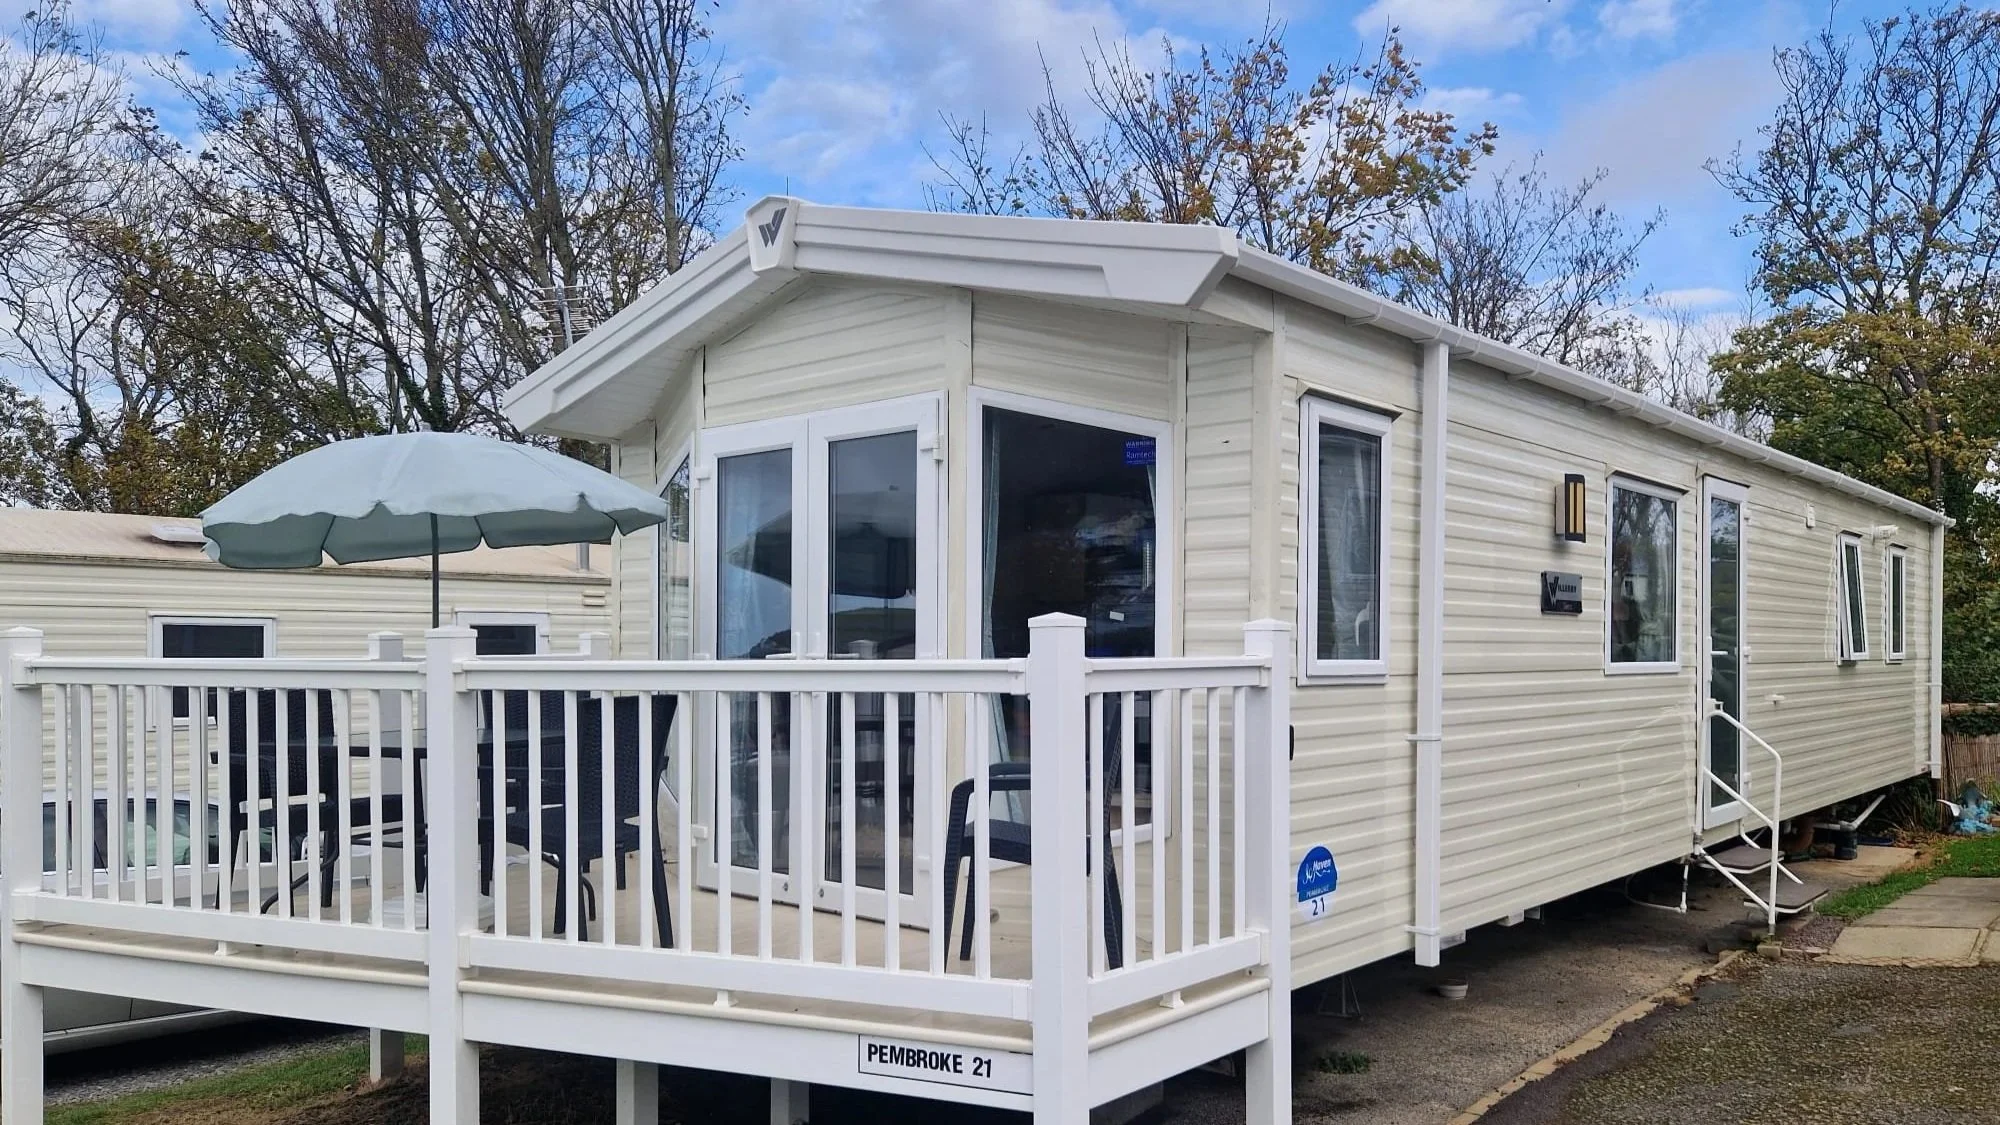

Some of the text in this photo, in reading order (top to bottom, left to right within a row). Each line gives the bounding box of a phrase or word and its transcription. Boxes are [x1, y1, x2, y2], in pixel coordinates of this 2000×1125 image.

[1312, 897, 1325, 916] 21
[867, 1043, 992, 1078] PEMBROKE 21
